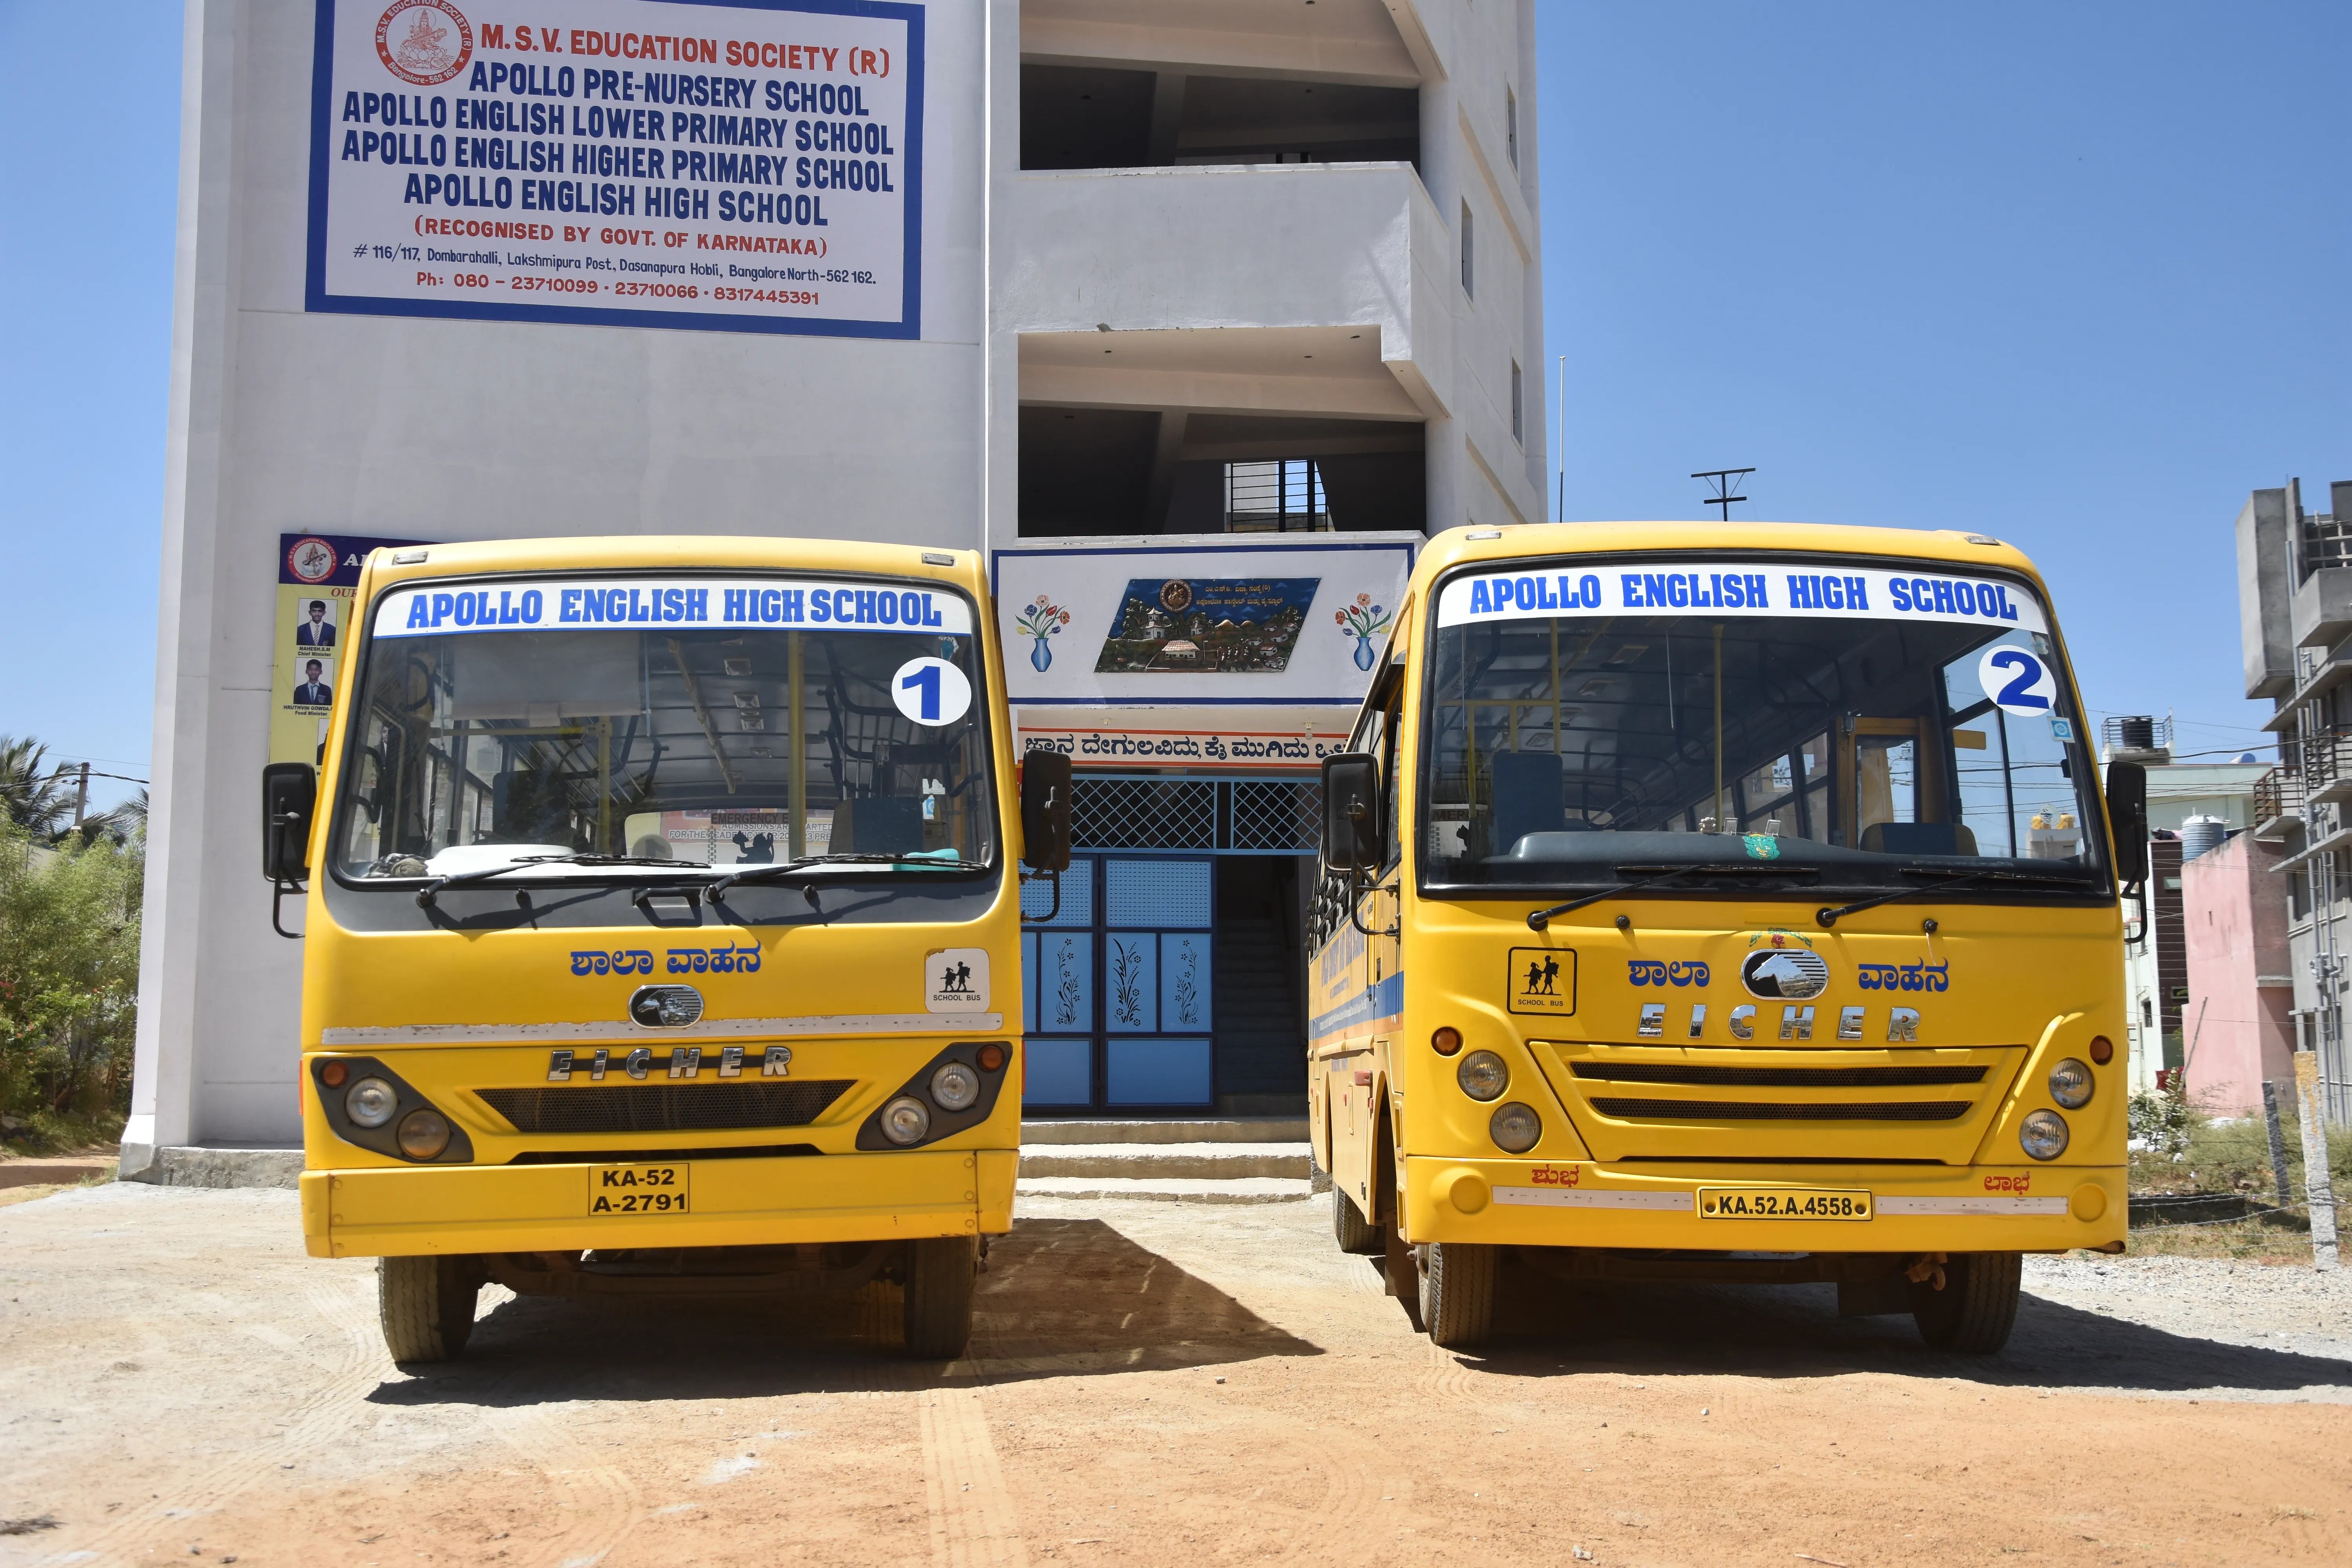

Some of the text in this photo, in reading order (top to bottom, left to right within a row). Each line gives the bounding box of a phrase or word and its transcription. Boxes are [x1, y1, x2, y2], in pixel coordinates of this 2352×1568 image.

[440, 2, 470, 34] SOCIETY
[463, 38, 472, 51] (R)
[571, 30, 717, 64] EDUCATION
[726, 40, 839, 72] SOCIETY
[849, 46, 889, 78] (R)
[469, 61, 869, 116] APOLLO PRE-NURSERY SCHOOL
[343, 91, 894, 155] APOLLO ENGLISH LOWER PRIMARY SCHOOL
[341, 130, 894, 192] APOLLO ENGLISH HIGHER PRIMARY SCHOOL
[404, 173, 828, 226] APOLLO ENGLISH HIGH SCHOOL
[415, 214, 827, 258] (RECOGNISED BY GOVT. OF KARNATAKA)
[428, 248, 502, 267] Dombarahalli,
[508, 252, 581, 271] Lakshmipura
[586, 258, 616, 272] Post,
[620, 259, 685, 277] Dasanapura
[691, 262, 724, 280] Hobli,
[417, 272, 444, 286] Ph:
[454, 273, 489, 288] 080
[512, 276, 598, 294] 23710099
[615, 282, 698, 299] 23710066
[714, 287, 819, 305] 8317445391
[295, 539, 319, 548] EDUCATION
[320, 540, 334, 554] SOCIETY
[406, 589, 942, 628] APOLLO ENGLISH HIGH SCHOOL
[1470, 573, 2018, 621] APOLLO ENGLISH HIGH SCHOOL
[902, 666, 940, 720] 1
[1991, 650, 2049, 709] 2
[1205, 736, 1227, 760] ಕೈ
[1232, 737, 1309, 758] ಮುಗಿದು
[669, 830, 687, 838] FOR
[707, 831, 753, 839] ACADEIC
[711, 813, 778, 824] EMERGENCY
[570, 939, 761, 976] ಶಾಲಾ ವಾಹನ
[1628, 956, 1949, 992] ಶಾಲಾ ವಾಹನ
[1637, 1003, 1920, 1042] EICHER
[548, 1046, 791, 1081] EICHER
[603, 1169, 675, 1187] KA-52
[1531, 1164, 1580, 1187] ಶುಭ
[1984, 1171, 2031, 1195] ಲಾಭ
[592, 1193, 685, 1212] A-2791
[1719, 1196, 1852, 1216] KA.52.A.4558
